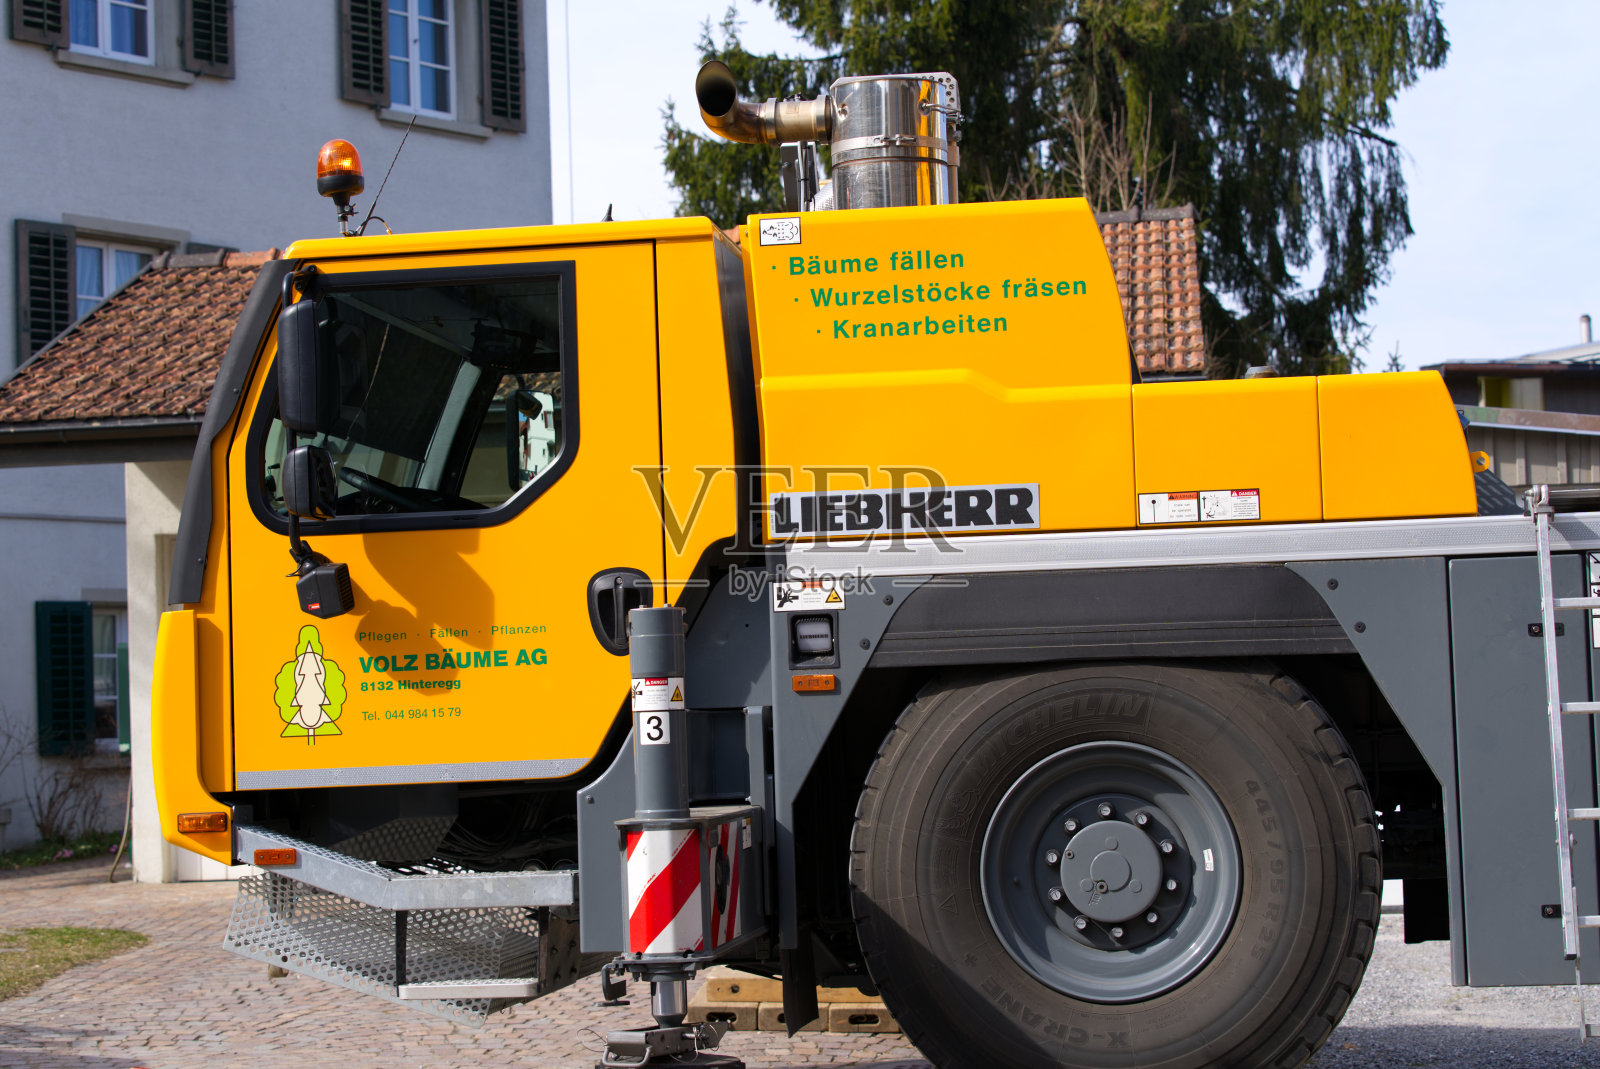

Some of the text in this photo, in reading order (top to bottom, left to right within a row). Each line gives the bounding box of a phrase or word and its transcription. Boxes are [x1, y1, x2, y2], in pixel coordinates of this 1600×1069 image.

[789, 249, 965, 276] Bäume fällen
[810, 276, 1088, 308] Wurzelstöcke fräsen
[833, 313, 1008, 339] Kranarbeiten
[774, 487, 1035, 534] LIEBHERR
[359, 624, 547, 643] Pflegen Fällen Pflanzen
[359, 648, 548, 674] VOLZ BÄUME AG
[360, 679, 462, 692] 8132 Hinteregg
[361, 706, 462, 721] Tel. 044 984 15 79
[646, 715, 664, 741] 3
